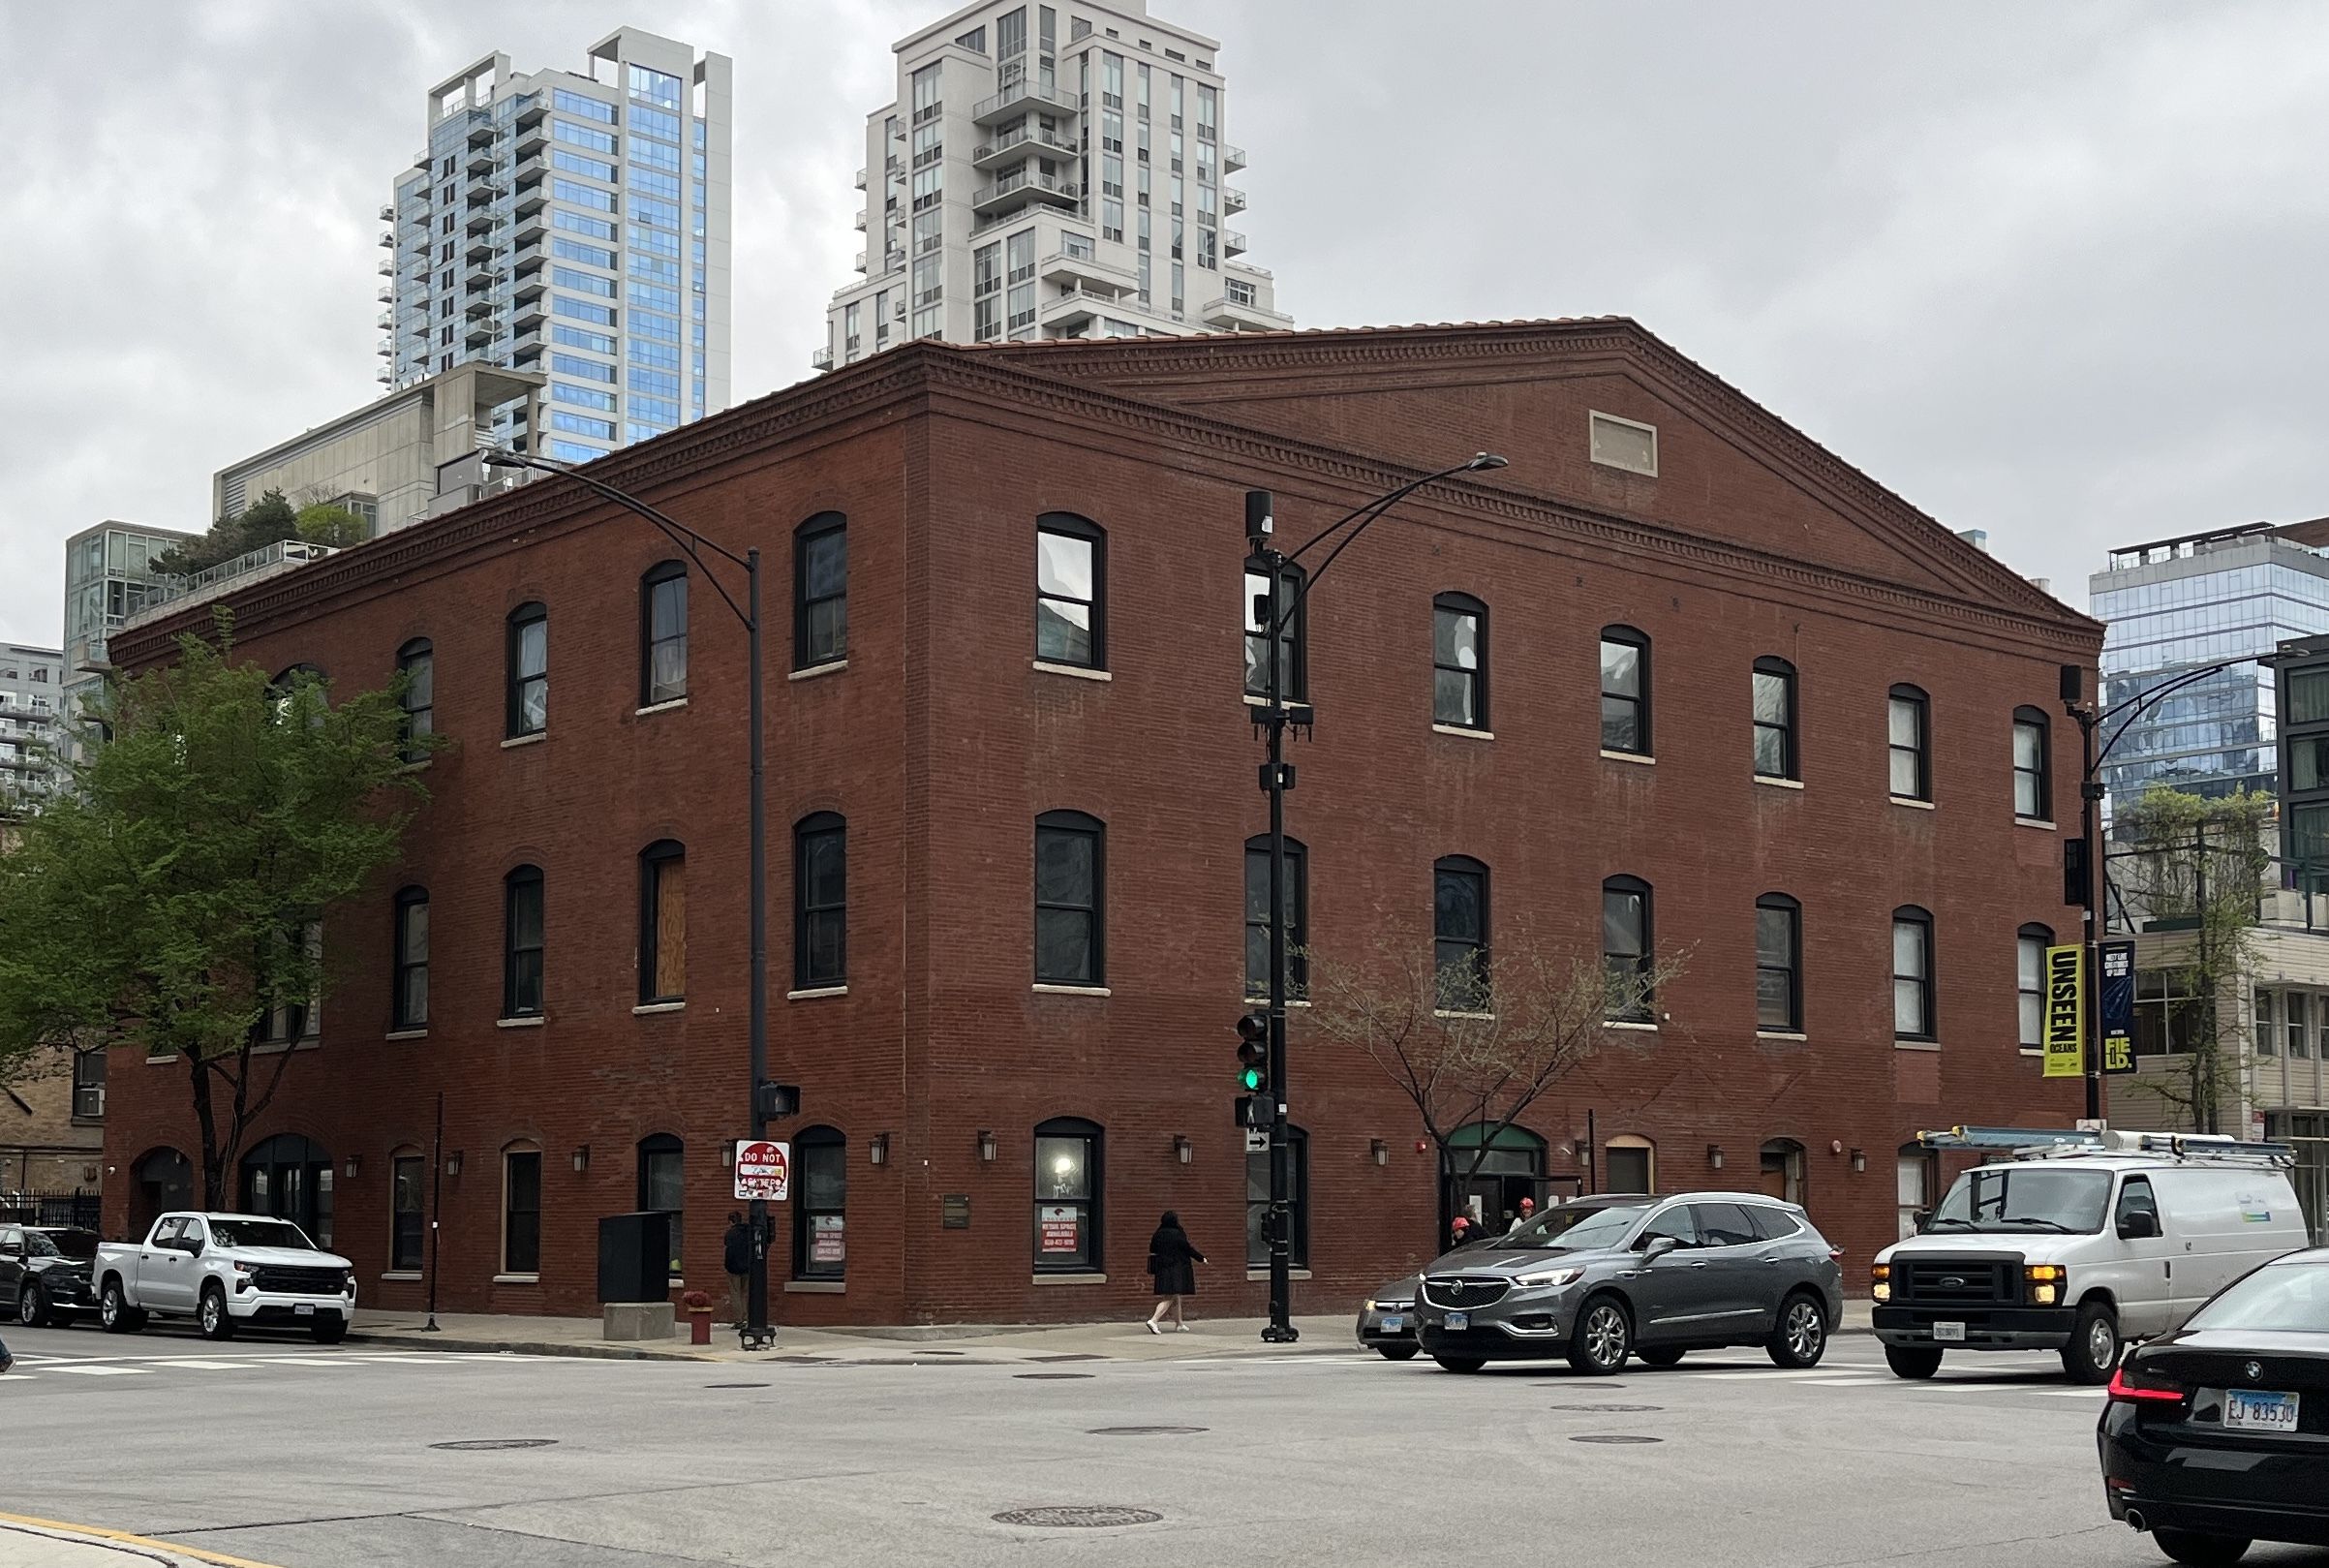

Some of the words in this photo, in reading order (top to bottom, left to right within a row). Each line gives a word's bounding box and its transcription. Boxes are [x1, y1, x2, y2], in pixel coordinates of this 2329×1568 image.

[2051, 951, 2077, 1041] UNSEEN
[745, 1153, 757, 1161] DO
[762, 1153, 781, 1163] NOT
[2229, 1400, 2245, 1419] EJ
[2253, 1401, 2293, 1422] 83530
